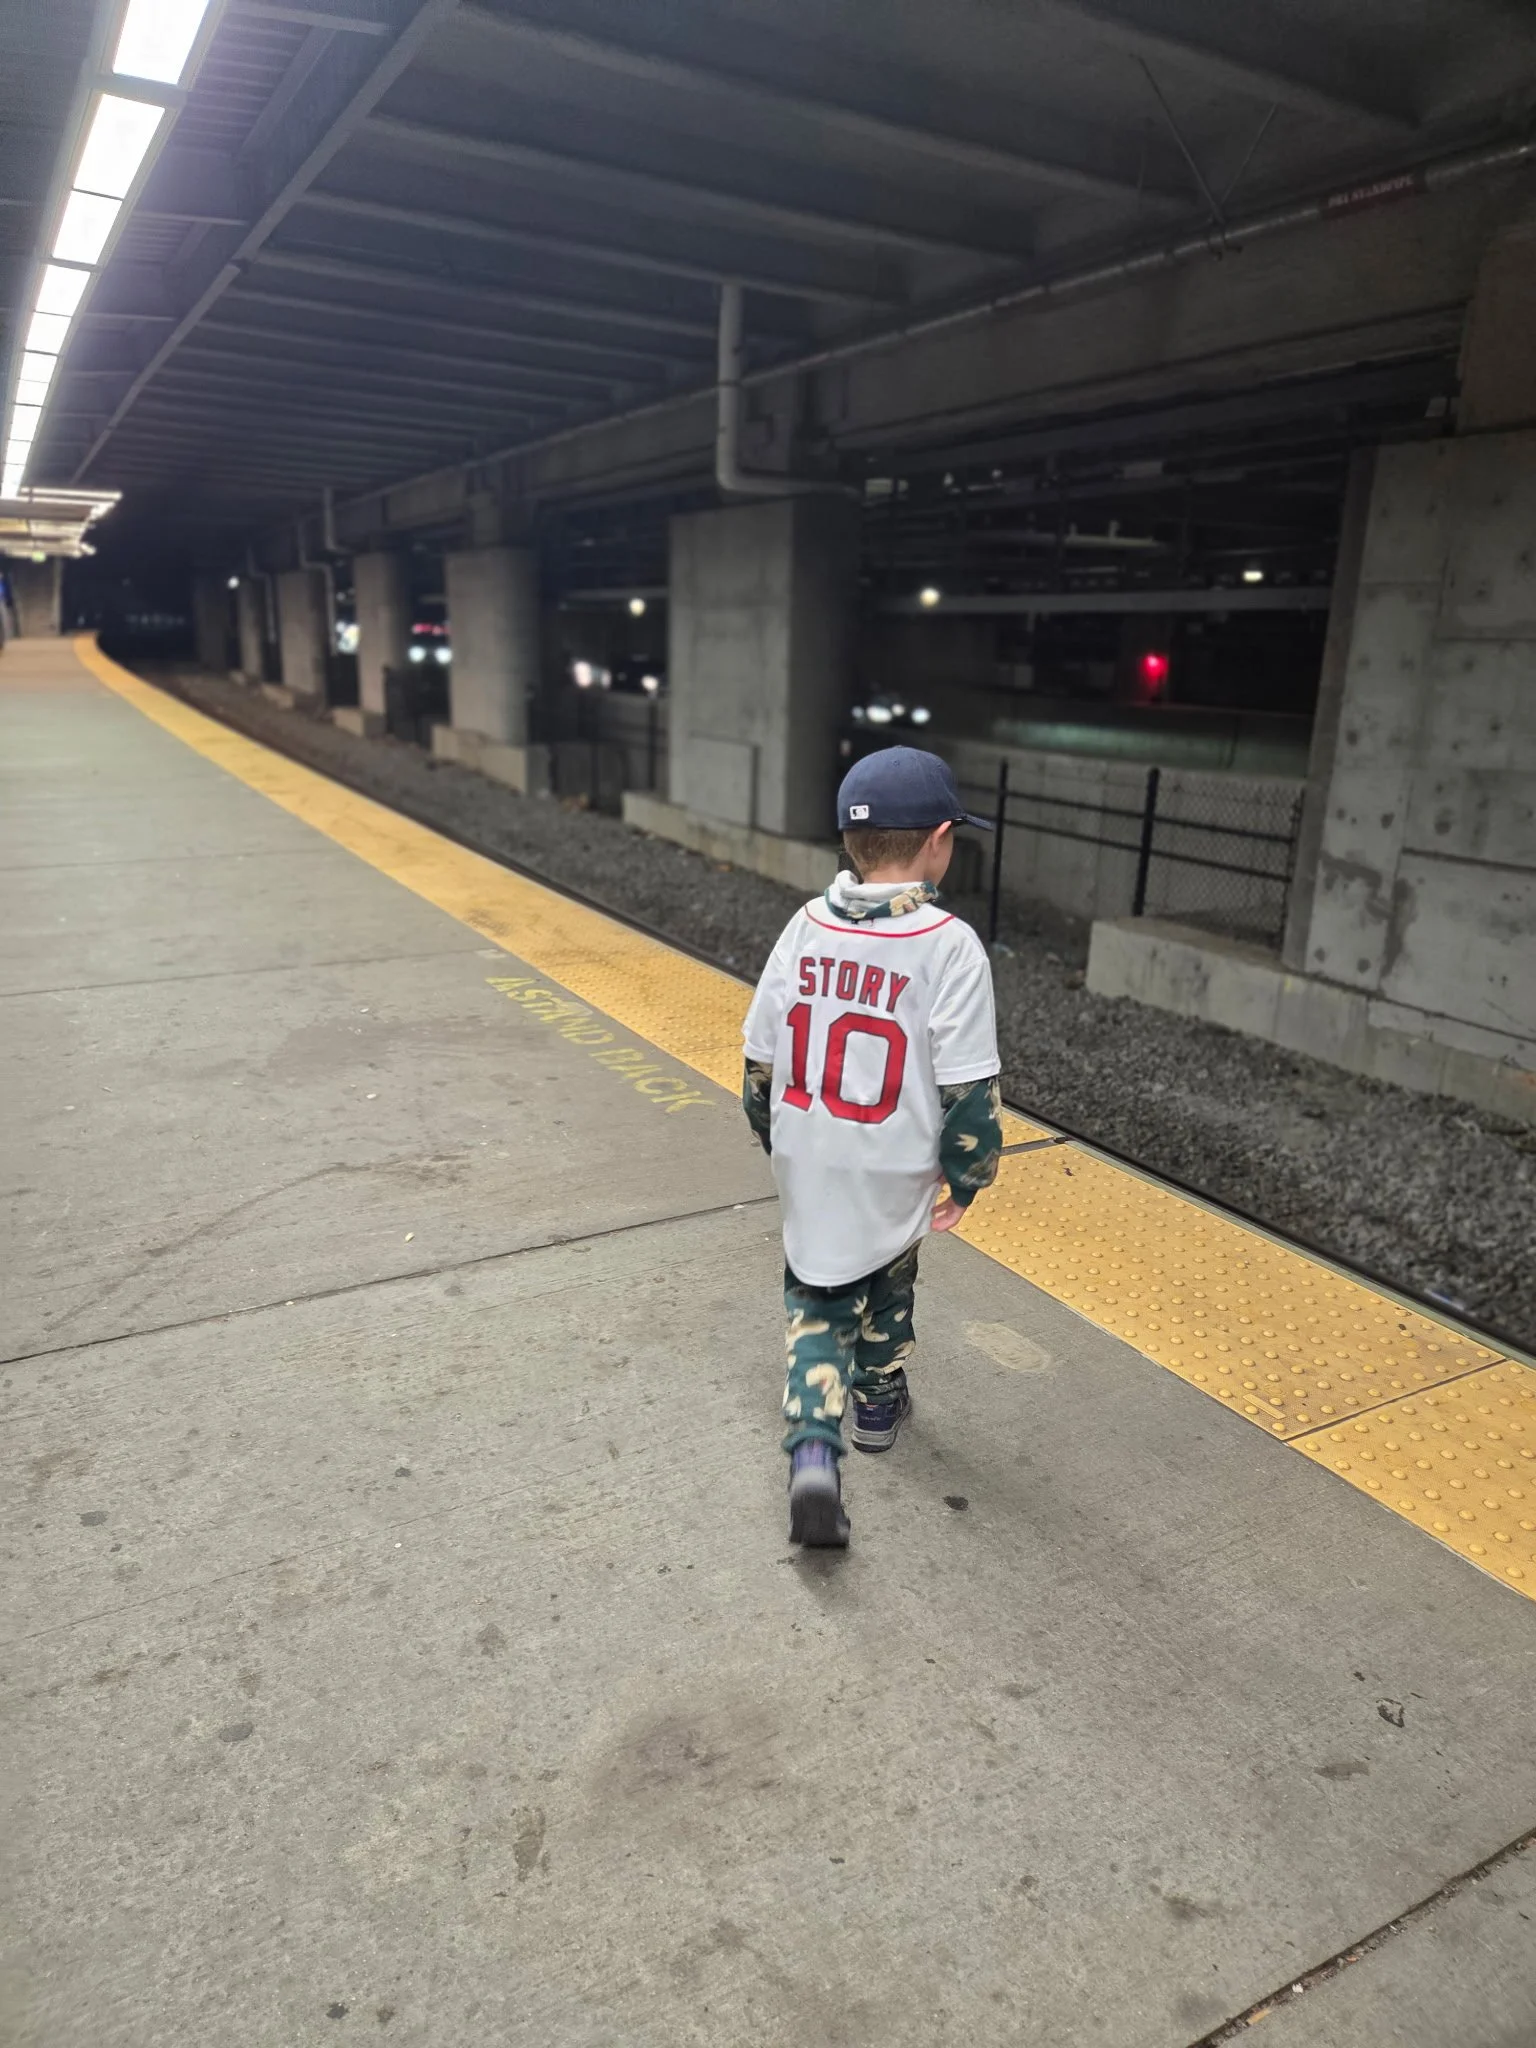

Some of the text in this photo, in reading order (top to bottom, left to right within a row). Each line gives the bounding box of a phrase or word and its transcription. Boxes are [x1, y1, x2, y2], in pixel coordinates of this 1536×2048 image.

[799, 956, 910, 1014] STORY
[588, 1048, 717, 1113] BACK
[781, 1002, 908, 1125] 10
